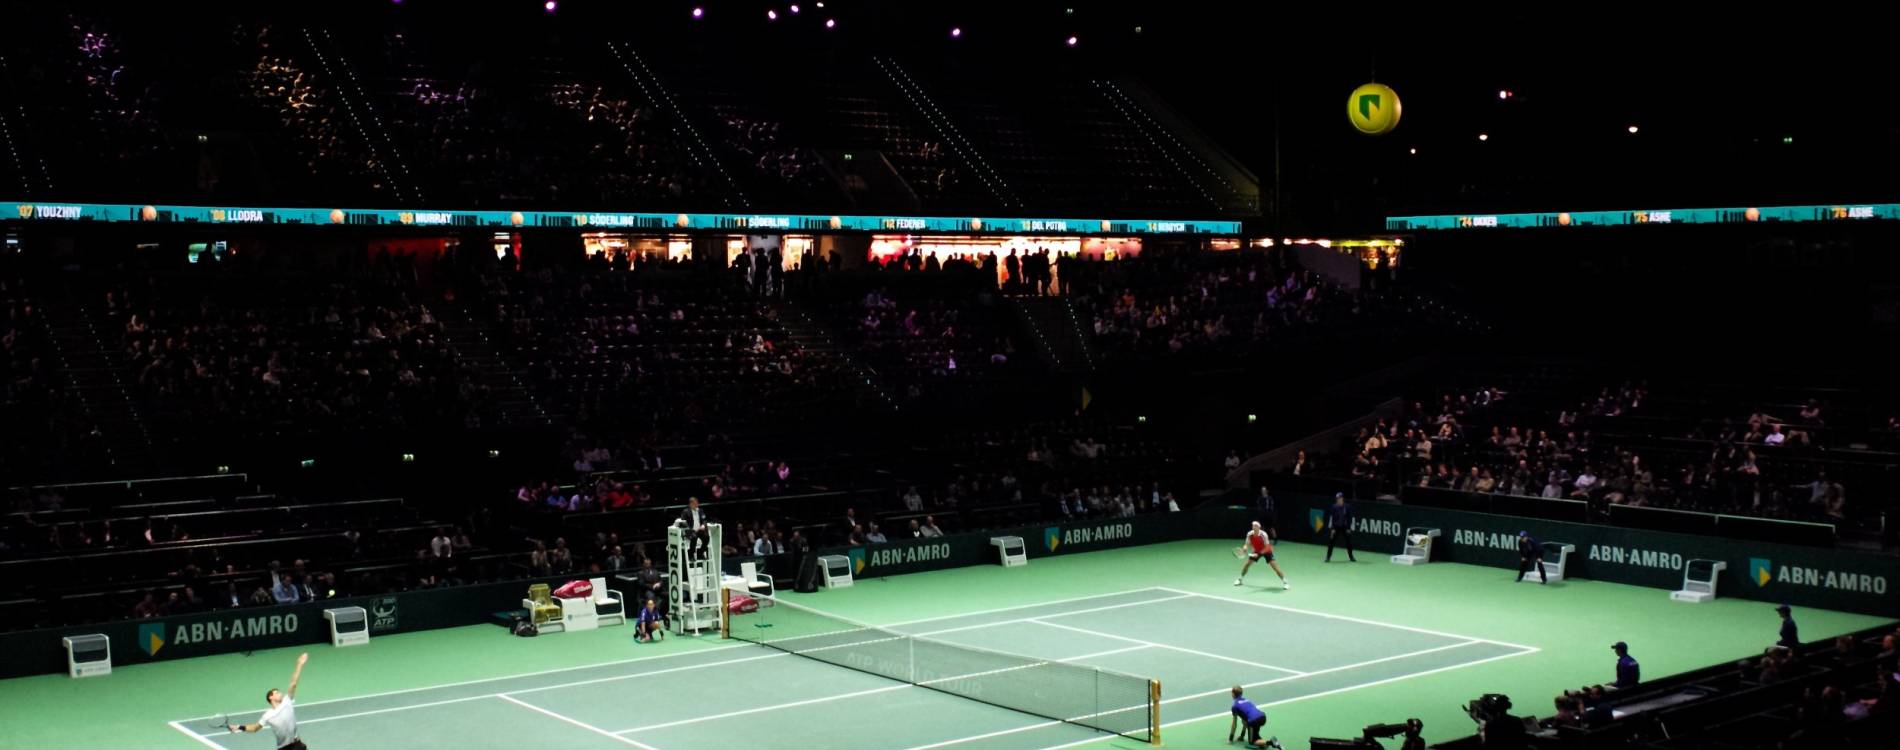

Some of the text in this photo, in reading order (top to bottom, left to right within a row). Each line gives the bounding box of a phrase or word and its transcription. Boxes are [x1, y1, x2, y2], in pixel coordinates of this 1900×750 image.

[36, 205, 81, 218] YOUZHNY
[227, 210, 263, 221] LLODRA
[415, 213, 451, 224] MURRAY
[669, 543, 680, 622] RICOH
